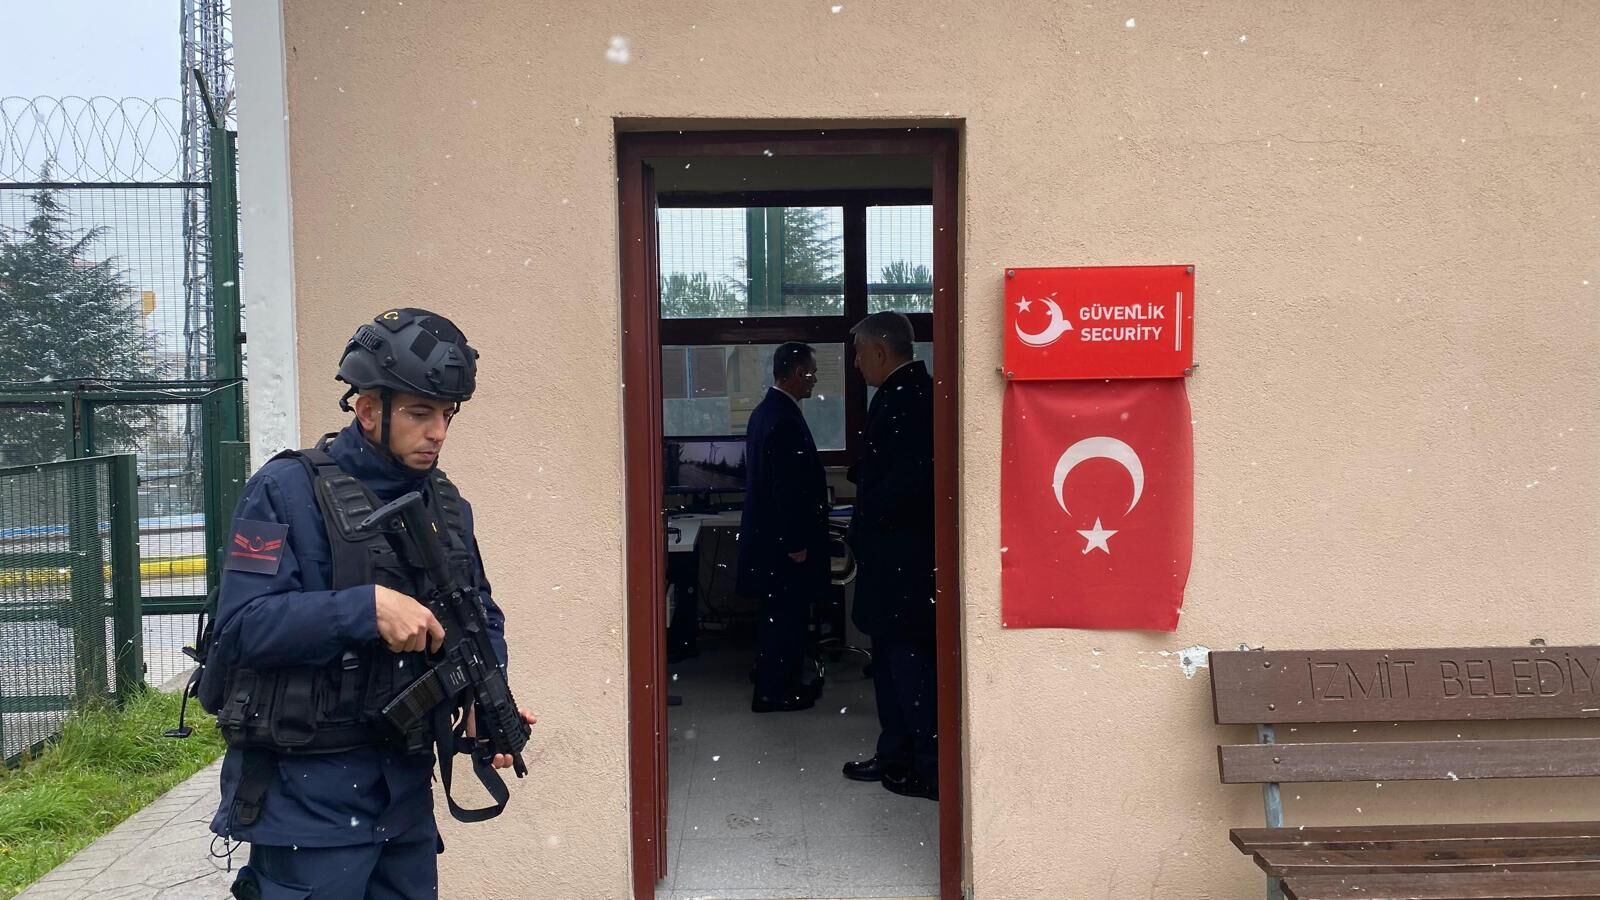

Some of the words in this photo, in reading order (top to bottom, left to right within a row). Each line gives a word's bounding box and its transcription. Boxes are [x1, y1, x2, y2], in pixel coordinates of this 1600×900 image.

[1079, 302, 1165, 321] GÜVENLİK
[1306, 656, 1416, 700] İZMİT
[1439, 653, 1600, 698] BELEDİY
